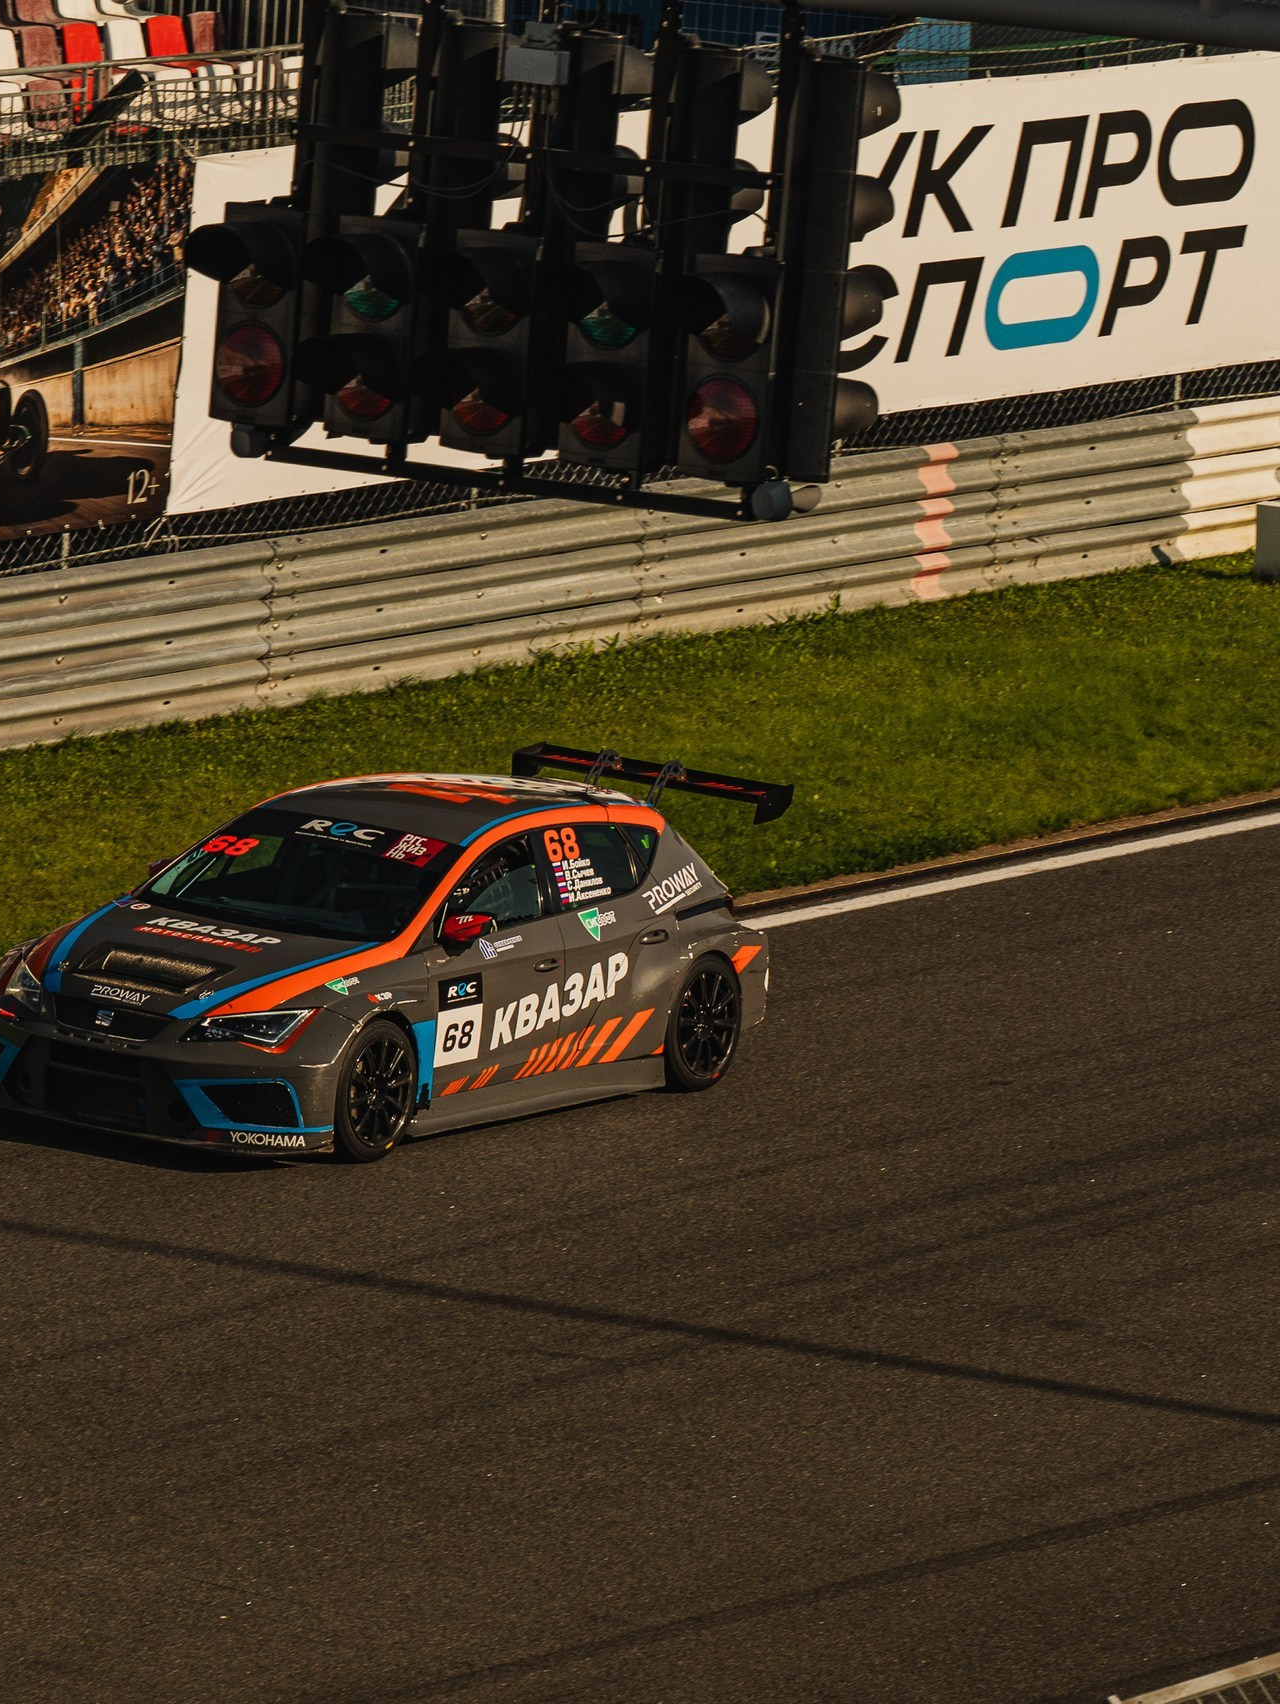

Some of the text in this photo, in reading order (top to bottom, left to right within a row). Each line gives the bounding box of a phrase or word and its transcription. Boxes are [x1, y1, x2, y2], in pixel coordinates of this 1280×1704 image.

[1001, 98, 1255, 229] ПРО
[126, 468, 160, 505] 12+
[202, 835, 260, 856] 68
[401, 833, 427, 847] РГС
[543, 827, 580, 862] 68
[641, 862, 699, 910] PROWAY
[146, 916, 282, 945] КВАЗАР
[91, 984, 151, 1003] PROWAY
[490, 952, 629, 1051] КВАЗАР
[442, 1020, 474, 1053] 68
[230, 1131, 306, 1147] YOKOHAMA
